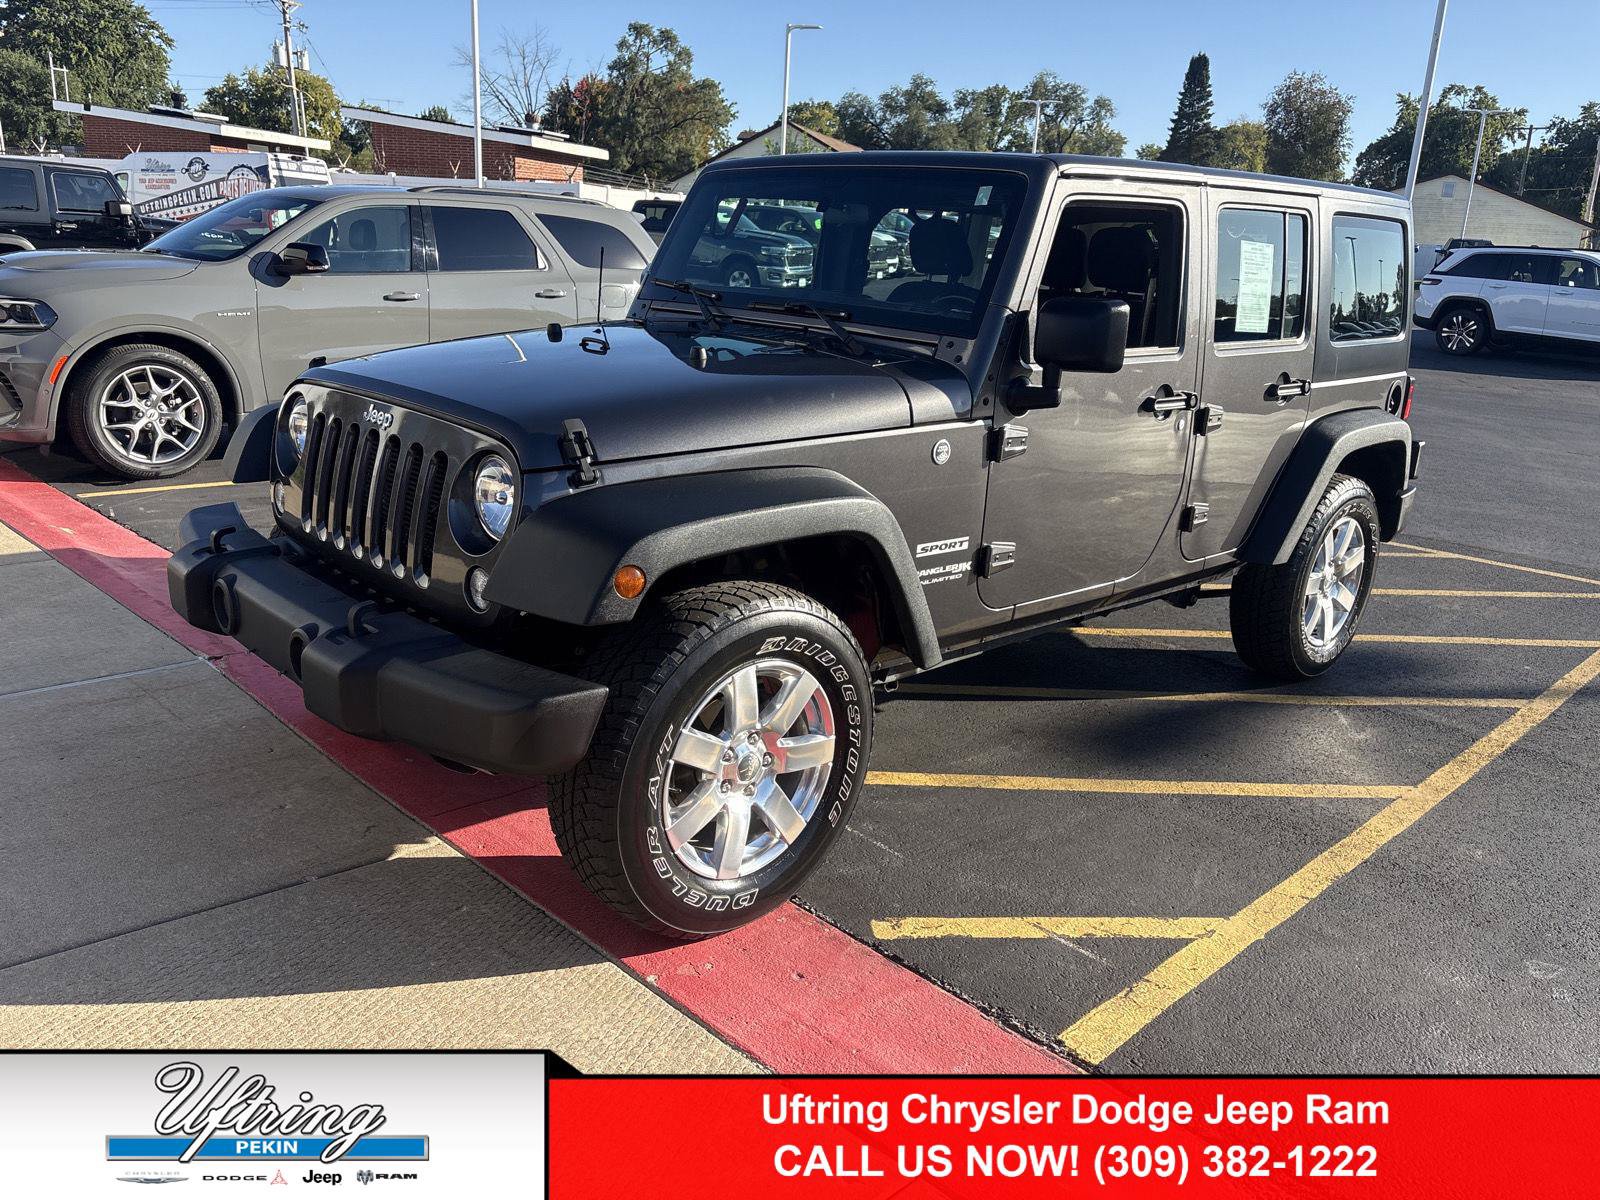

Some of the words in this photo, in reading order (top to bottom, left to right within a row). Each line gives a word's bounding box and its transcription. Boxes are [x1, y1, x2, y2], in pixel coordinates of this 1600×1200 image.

[140, 182, 218, 214] UFTRINGPEKIN.COM
[363, 403, 394, 430] Jeep
[920, 541, 966, 554] SPORT
[917, 563, 959, 577] ANGLER
[920, 573, 963, 585] NLIMITED
[756, 636, 861, 828] BRIDGESTONE
[648, 724, 674, 810] A/T
[647, 826, 759, 911] DUELER
